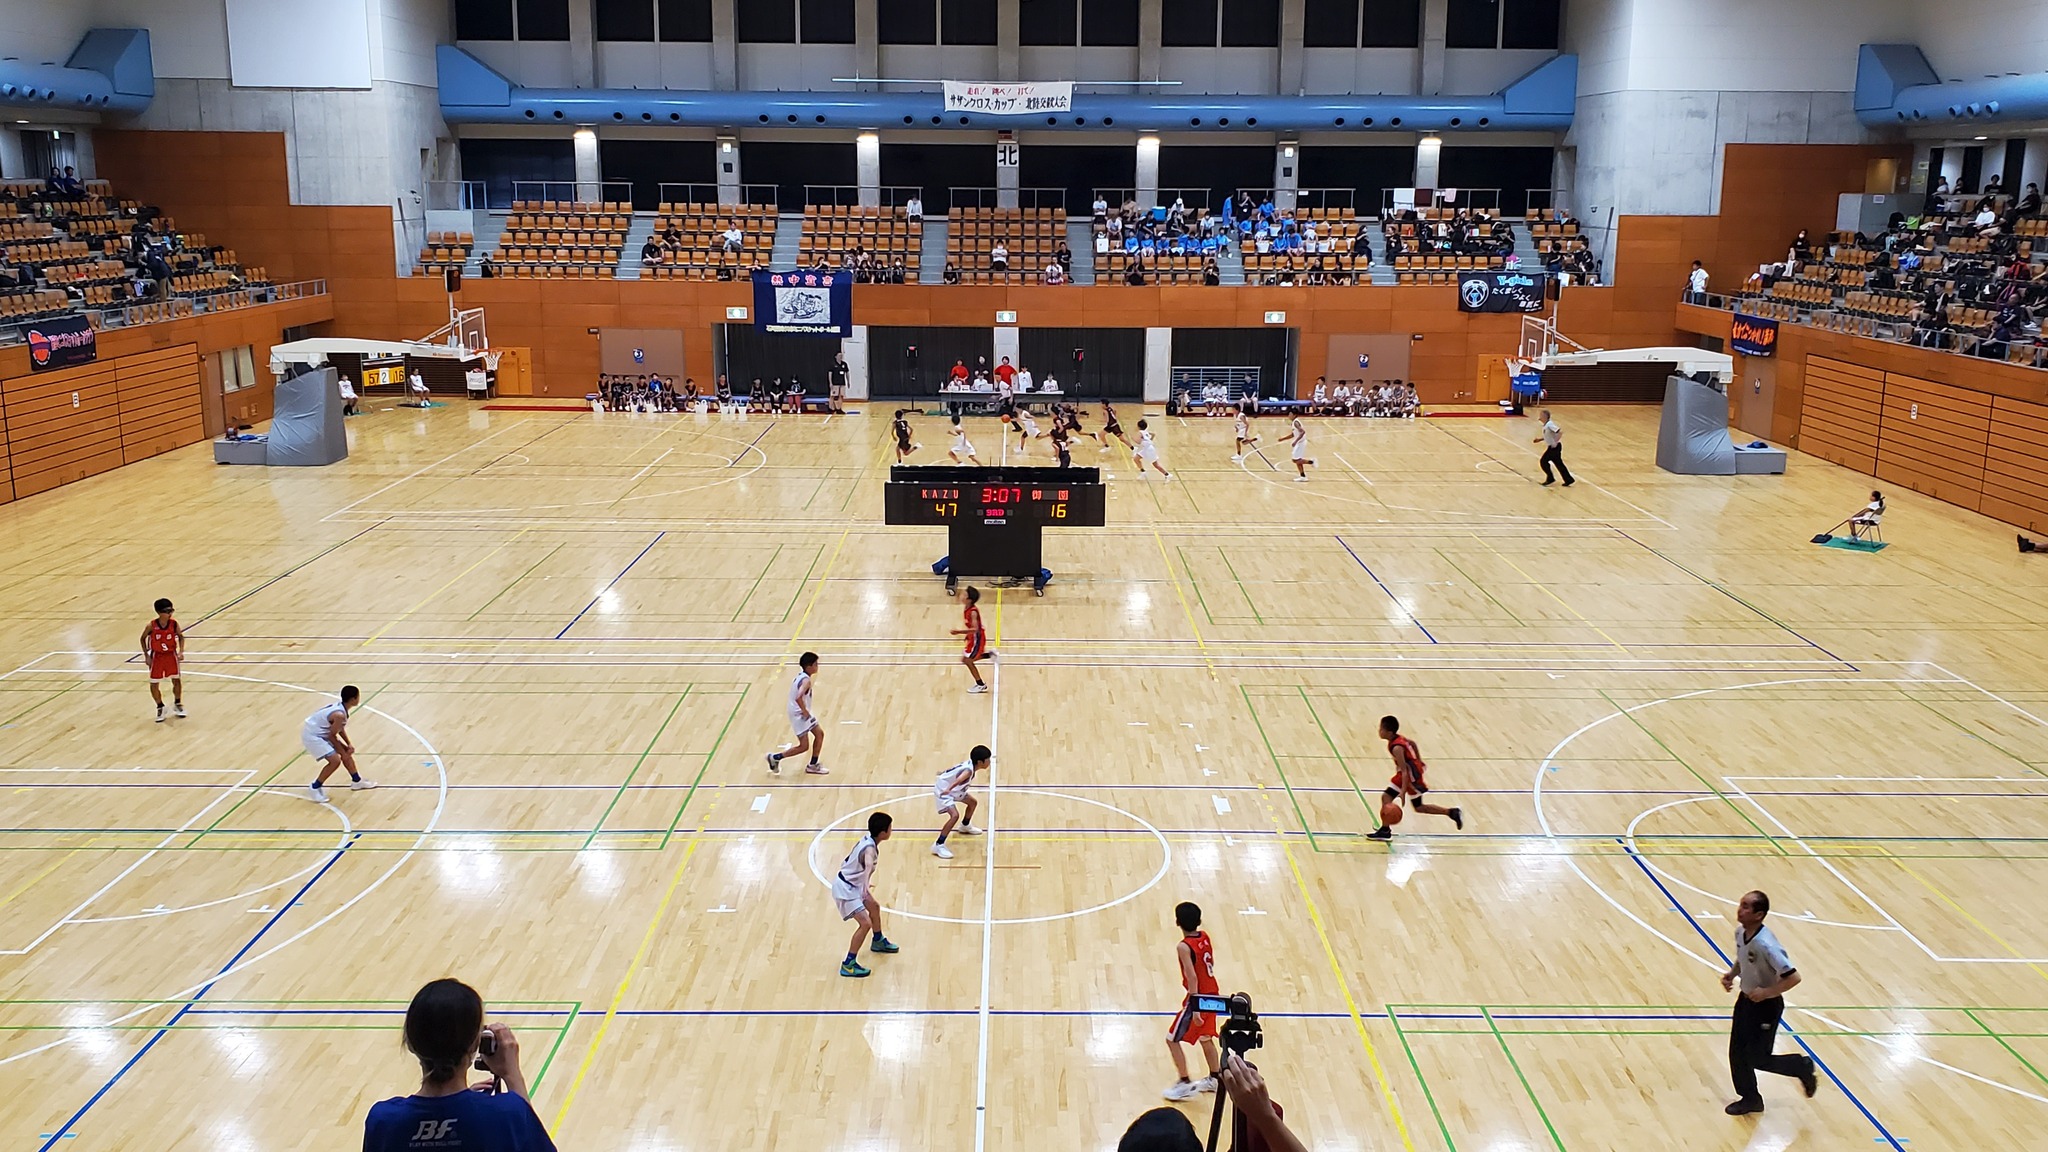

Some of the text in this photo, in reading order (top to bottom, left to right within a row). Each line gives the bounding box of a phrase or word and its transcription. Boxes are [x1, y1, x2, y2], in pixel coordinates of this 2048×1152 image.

[998, 145, 1018, 166] 北
[1491, 287, 1524, 295] たくましく
[369, 370, 404, 384] 57 2 16
[921, 489, 959, 499] KAZU
[981, 488, 1021, 502] 3:07
[935, 503, 958, 517] 47
[1050, 503, 1067, 518] 16
